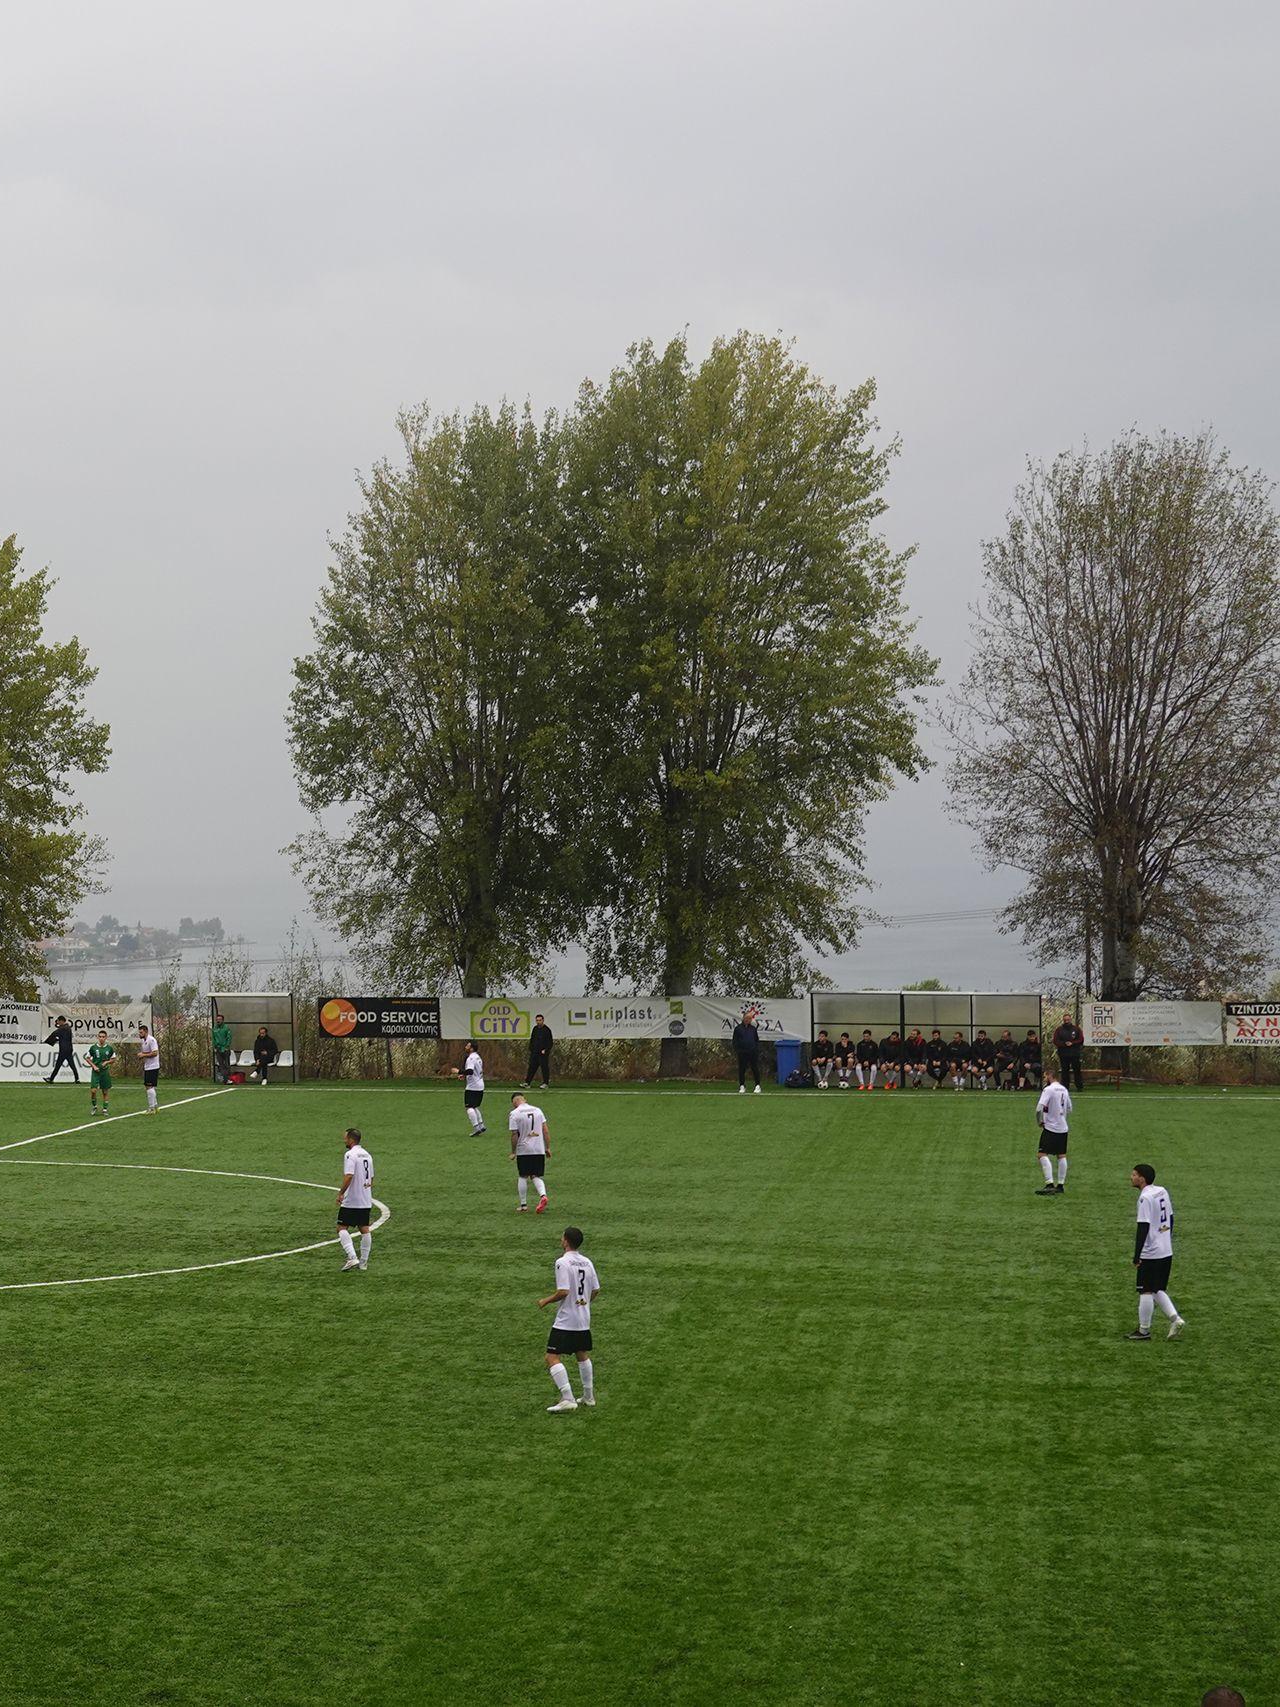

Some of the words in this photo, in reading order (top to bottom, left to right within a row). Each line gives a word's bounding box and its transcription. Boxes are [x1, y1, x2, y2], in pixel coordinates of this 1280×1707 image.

[339, 1011, 377, 1023] FOOD
[381, 1011, 438, 1023] SERVICE
[489, 1006, 511, 1015] OLD
[589, 1006, 652, 1023] lariplast
[381, 1024, 438, 1035] καρακατσάνης
[527, 1113, 535, 1131] 7
[1159, 1198, 1167, 1223] 5
[578, 1269, 585, 1295] 3
